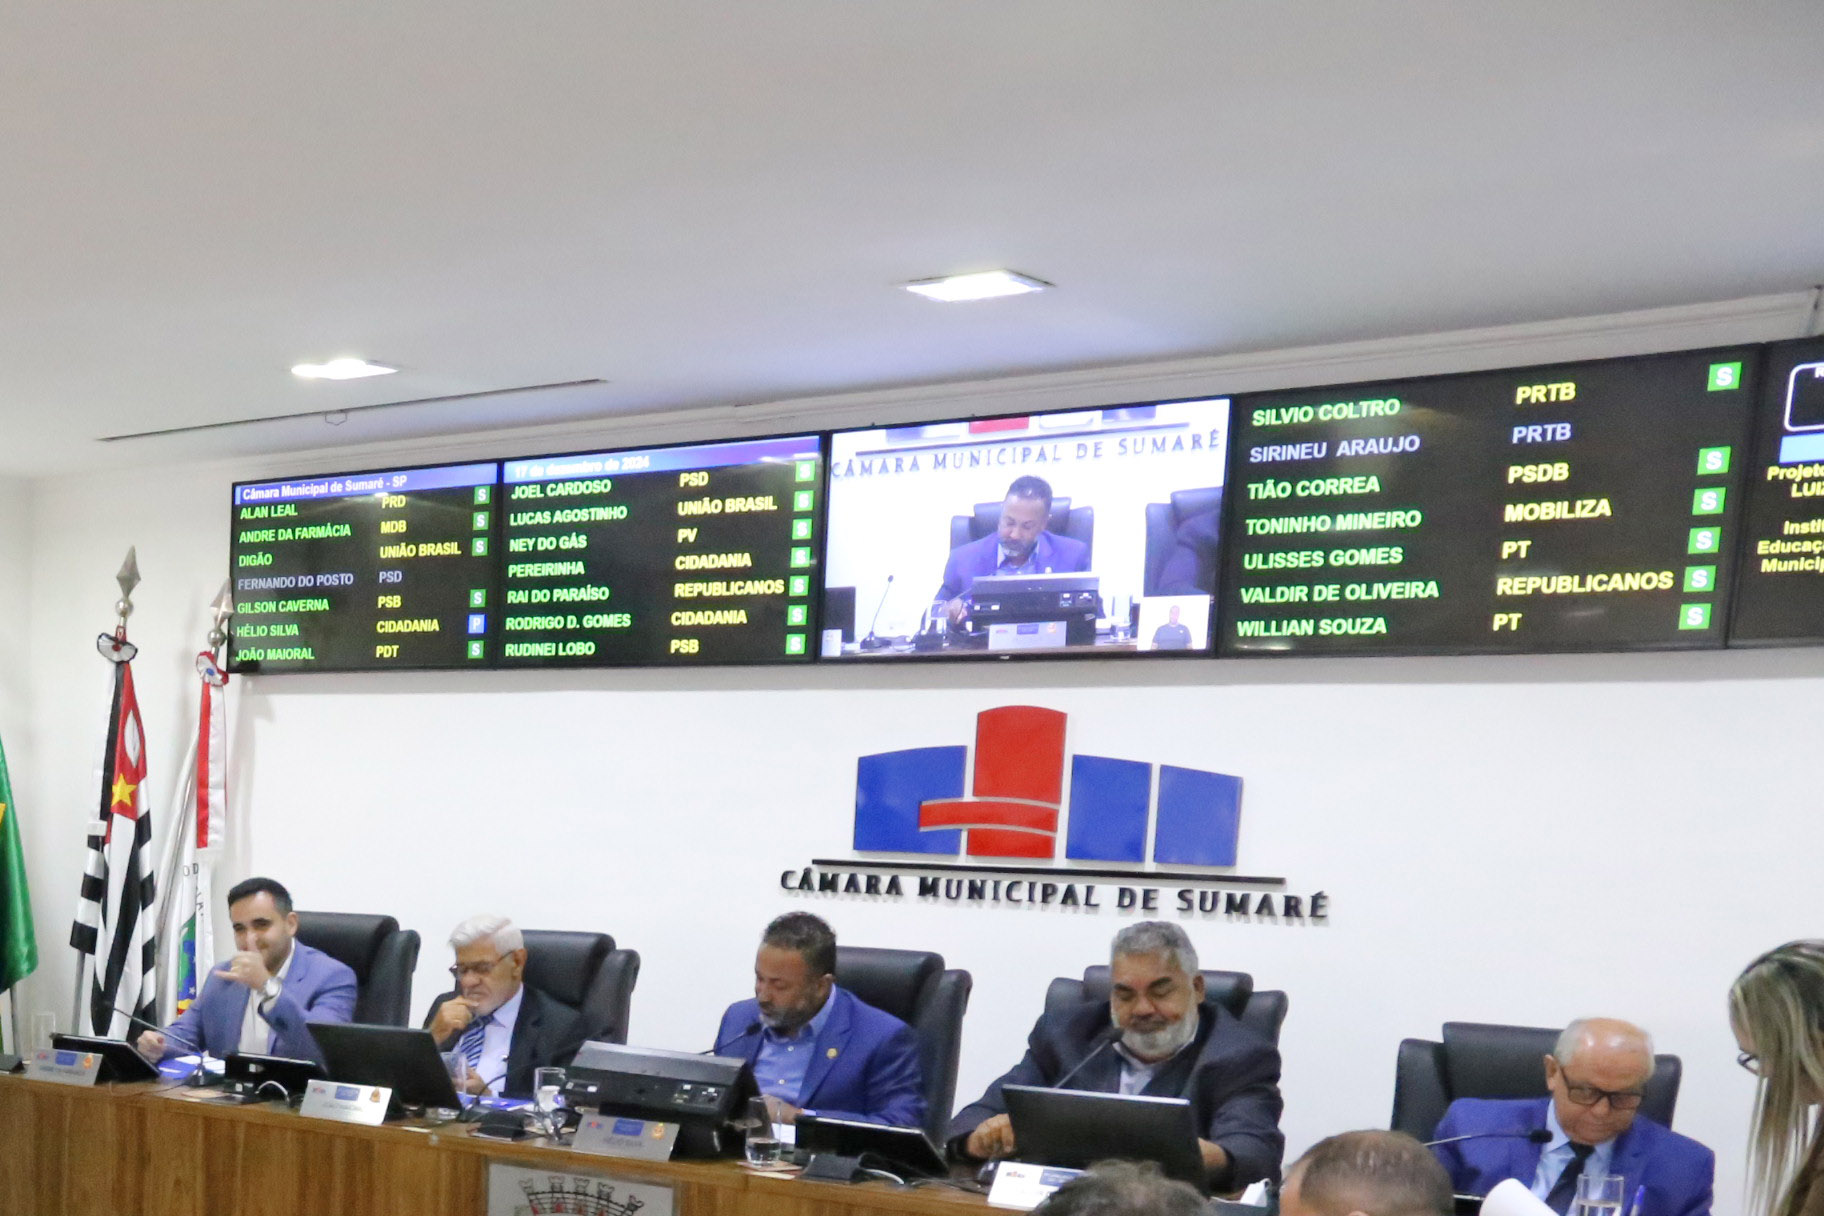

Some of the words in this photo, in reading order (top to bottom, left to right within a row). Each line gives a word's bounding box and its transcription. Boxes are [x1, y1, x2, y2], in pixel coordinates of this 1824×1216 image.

[1252, 406, 1313, 426] SILVIO
[1318, 398, 1401, 421] COLTRO
[1515, 382, 1576, 404] PRTB
[1716, 367, 1733, 386] S
[933, 444, 1063, 470] MUNICIPAL
[1076, 441, 1103, 460] DE
[1117, 428, 1221, 456] SUMARÉ
[1249, 442, 1327, 463] SIRINEU
[1336, 435, 1420, 457] ARAUJO
[1512, 423, 1571, 444] PRTB
[515, 465, 528, 478] 17
[530, 464, 544, 477] de
[604, 458, 619, 471] de
[622, 456, 650, 470] 2024
[1247, 479, 1292, 500] TIÃO
[1296, 476, 1380, 497] CORREA
[1508, 462, 1569, 484] PSDB
[1706, 451, 1722, 470] S
[1767, 463, 1824, 482] Projet
[243, 487, 279, 500] Câmara
[281, 482, 328, 498] Municipal
[330, 480, 343, 493] de
[345, 477, 384, 491] Sumaré
[392, 475, 407, 488] SP
[511, 485, 544, 499] JOEL
[546, 479, 611, 497] CARDOSO
[680, 472, 709, 487] PSD
[800, 464, 810, 478] S
[240, 506, 269, 520] ALAN
[271, 504, 298, 517] LEAL
[381, 495, 406, 508] PRD
[478, 489, 486, 501] S
[510, 511, 551, 526] LUCAS
[553, 506, 627, 524] AGOSTINHO
[678, 498, 723, 516] UNIÃO
[725, 496, 777, 513] BRASIL
[799, 494, 809, 508] S
[1245, 515, 1331, 535] TONINHO
[1335, 510, 1422, 531] MINEIRO
[1504, 499, 1612, 522] MOBILIZA
[1701, 491, 1718, 510] S
[239, 530, 276, 543] ANDRE
[278, 528, 293, 541] DA
[294, 523, 352, 540] FARMÁCIA
[380, 520, 406, 534] MDB
[477, 515, 485, 527] S
[509, 537, 535, 552] NEY
[537, 536, 557, 550] DO
[559, 532, 587, 548] GÁS
[678, 528, 697, 543] PV
[797, 522, 808, 536] S
[239, 553, 272, 567] DIGÃO
[380, 543, 416, 558] UNIÃO
[418, 542, 462, 556] BRASIL
[476, 541, 484, 553] S
[1244, 550, 1324, 570] ULISSES
[1329, 547, 1403, 566] GOMES
[1502, 541, 1531, 559] PT
[1695, 531, 1713, 550] S
[1757, 539, 1824, 555] Educaç
[508, 561, 584, 578] PEREIRINHA
[675, 552, 752, 570] CIDADANIA
[795, 550, 806, 565] S
[238, 577, 296, 591] FERNANDO
[298, 575, 314, 588] DO
[316, 573, 354, 587] POSTO
[379, 571, 402, 584] PSD
[507, 590, 529, 604] RAI
[531, 589, 550, 602] DO
[553, 584, 610, 601] PARAÍSO
[674, 580, 784, 598] REPUBLICANOS
[793, 579, 804, 593] S
[1240, 586, 1308, 604] VALDIR
[1312, 585, 1340, 602] DE
[1345, 581, 1439, 600] OLIVEIRA
[1496, 571, 1674, 596] REPUBLICANOS
[1691, 569, 1708, 588] S
[237, 600, 276, 614] GILSON
[278, 598, 329, 612] CAVERNA
[378, 595, 402, 609] PSB
[474, 592, 482, 605] S
[236, 624, 267, 638] HÉLIO
[269, 623, 299, 637] SILVA
[376, 619, 439, 633] CIDADANIA
[473, 618, 481, 630] P
[506, 616, 564, 631] RODRIGO
[567, 615, 580, 629] D.
[582, 613, 631, 629] GOMES
[671, 610, 747, 626] CIDADANIA
[792, 608, 803, 622] S
[1237, 619, 1314, 637] WILLIAN
[1319, 617, 1387, 635] SOUZA
[1493, 613, 1522, 631] PT
[1686, 607, 1703, 626] S
[236, 647, 264, 662] JOÃO
[266, 647, 315, 661] MAIORAL
[376, 645, 399, 658] PDT
[472, 644, 480, 656] S
[505, 643, 556, 657] RUDINEI
[559, 641, 595, 656] LOBO
[671, 639, 699, 653] PSB
[790, 637, 801, 651] S
[780, 866, 904, 896] CÂMARA
[918, 876, 1100, 907] MUNICIPAL
[1117, 887, 1159, 910] DE
[1176, 889, 1329, 918] SUMARÉ
